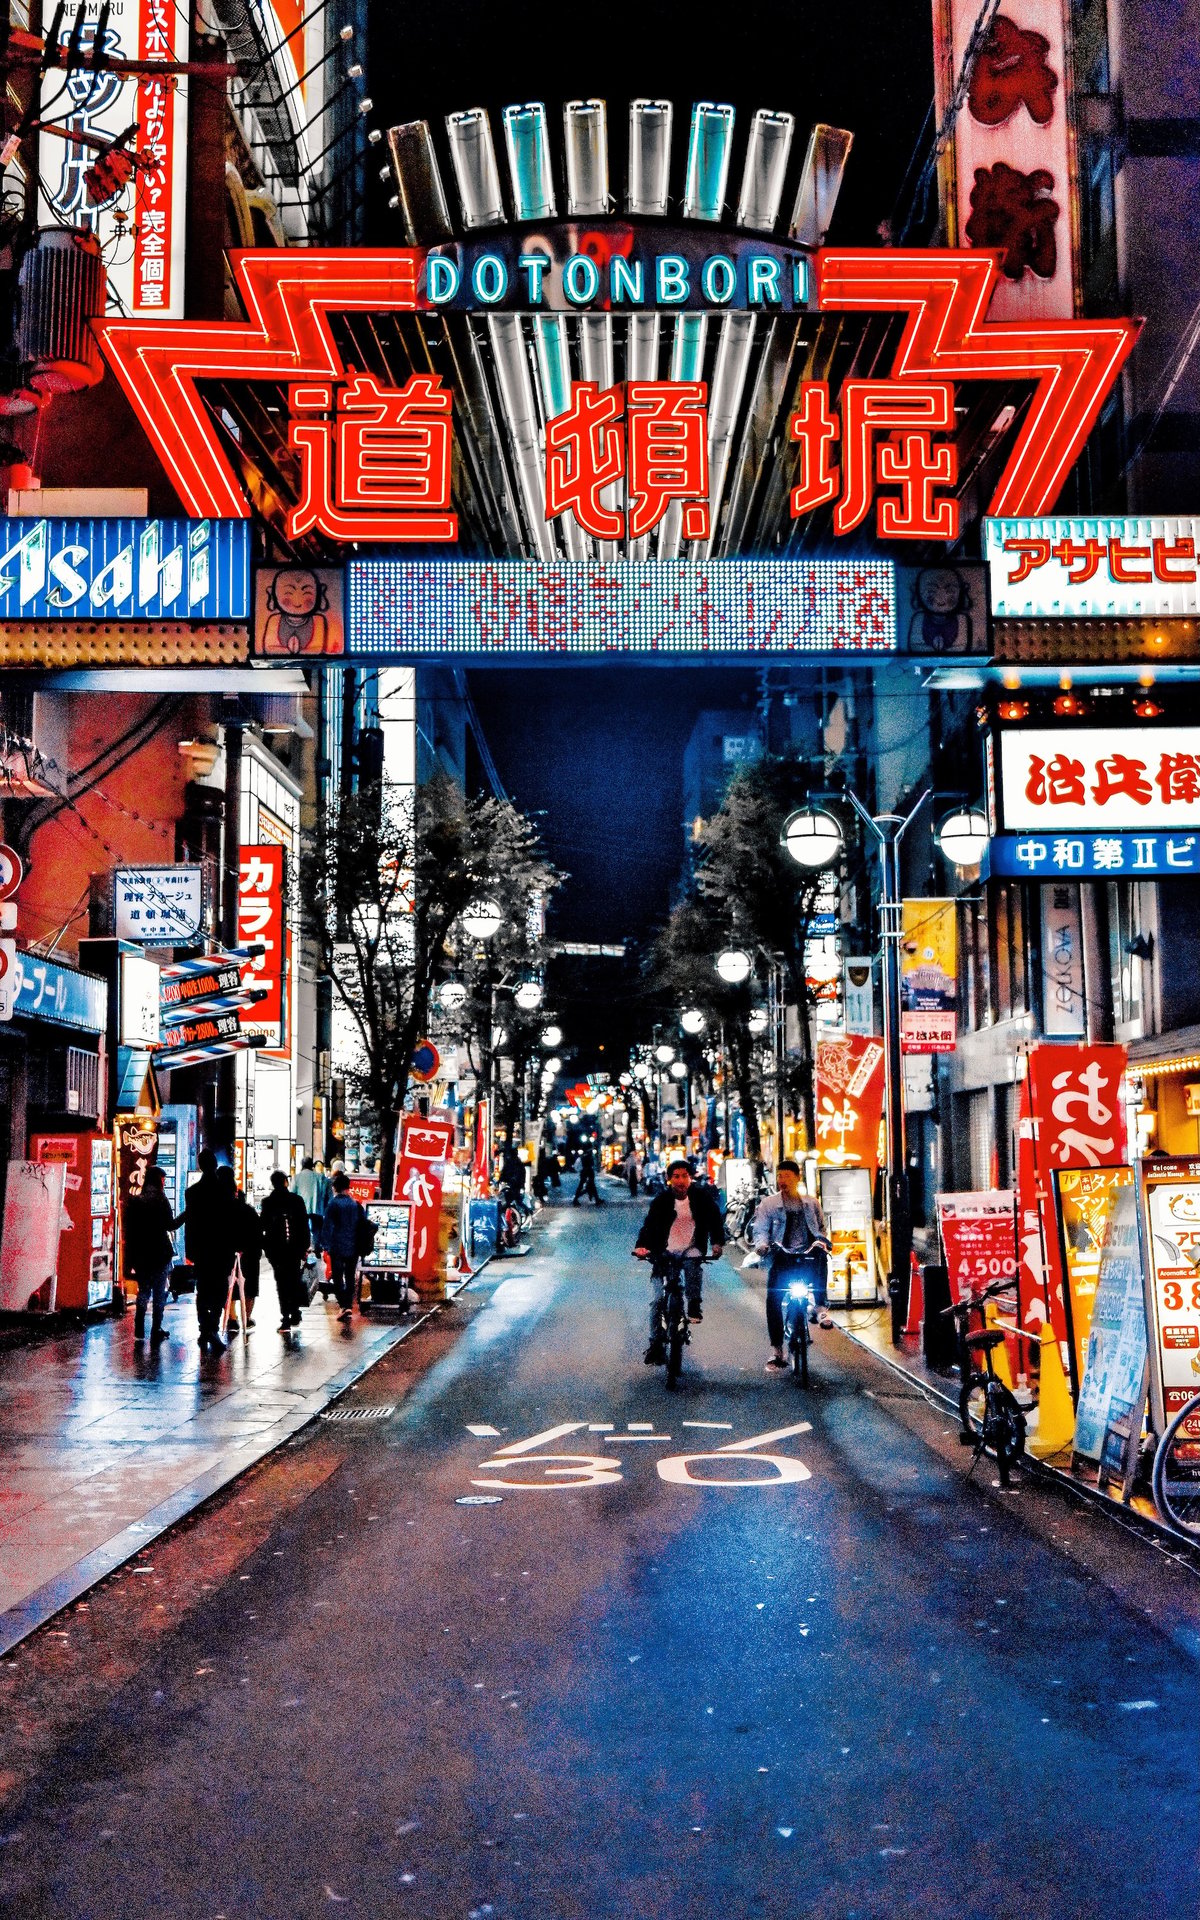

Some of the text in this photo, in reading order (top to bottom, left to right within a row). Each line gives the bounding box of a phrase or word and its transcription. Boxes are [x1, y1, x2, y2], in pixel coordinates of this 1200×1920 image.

[63, 2, 124, 16] NEMRU
[139, 209, 166, 306] 完全個室
[426, 254, 809, 305] DOTONBORI
[287, 373, 959, 542] 道頓堀
[0, 518, 211, 608] Asahi
[1003, 537, 1200, 584] アサヒビ
[239, 856, 274, 1010] カラオケ
[1062, 1174, 1076, 1185] 7F
[470, 1453, 813, 1489] 30
